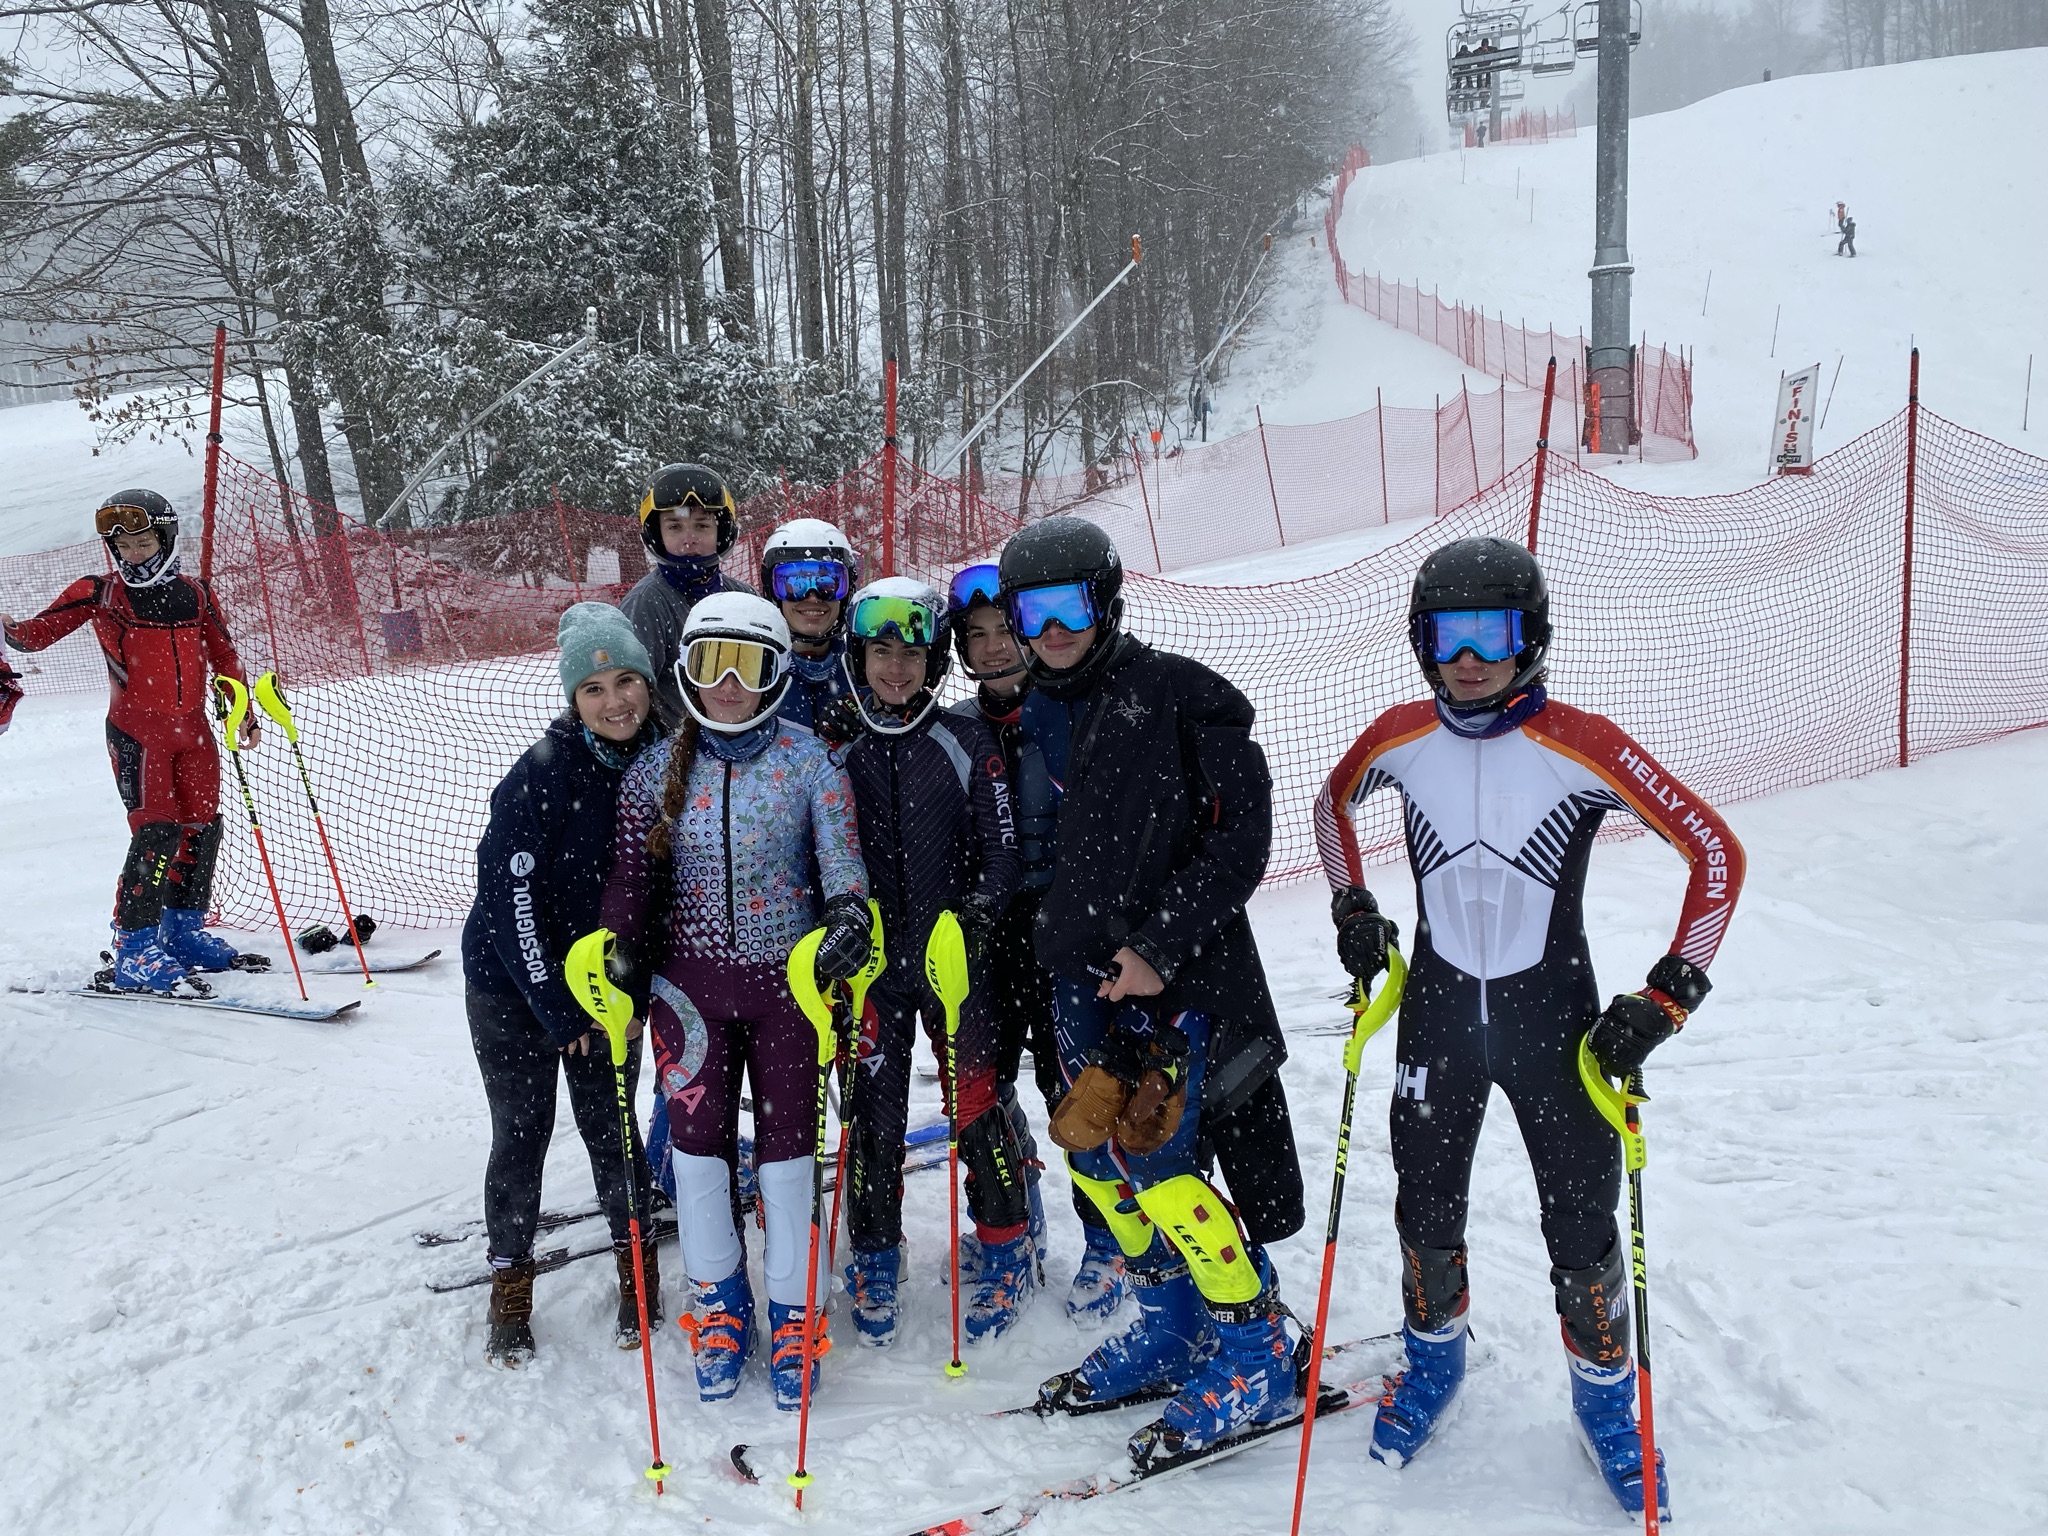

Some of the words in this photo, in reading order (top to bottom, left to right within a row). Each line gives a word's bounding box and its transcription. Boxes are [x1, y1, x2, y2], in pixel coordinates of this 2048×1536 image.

[1618, 746, 1685, 812] HELLY
[1682, 810, 1727, 899] HANSEN
[152, 854, 167, 886] LEKI
[513, 880, 549, 984] ROSSIGNOL
[818, 924, 849, 956] HESTRA
[865, 945, 880, 978] LEKI
[929, 957, 942, 993] LEKI
[588, 971, 608, 1013] LEKI
[1663, 1001, 1686, 1023] EKI
[850, 1018, 861, 1059] LEKI
[947, 1036, 956, 1077] LEKI
[615, 1072, 627, 1107] EKI
[815, 1073, 825, 1109] EKI
[816, 1114, 827, 1163] LEKI
[1335, 1122, 1351, 1176] LEKI
[854, 1158, 864, 1199] LEKI
[992, 1147, 1013, 1187] LEKI
[1173, 1225, 1213, 1263] LEKI
[1632, 1229, 1647, 1290] LEKI
[1409, 1247, 1428, 1322] ENGLERT
[1589, 1283, 1613, 1346] MASON
[1598, 1344, 1624, 1361] 24
